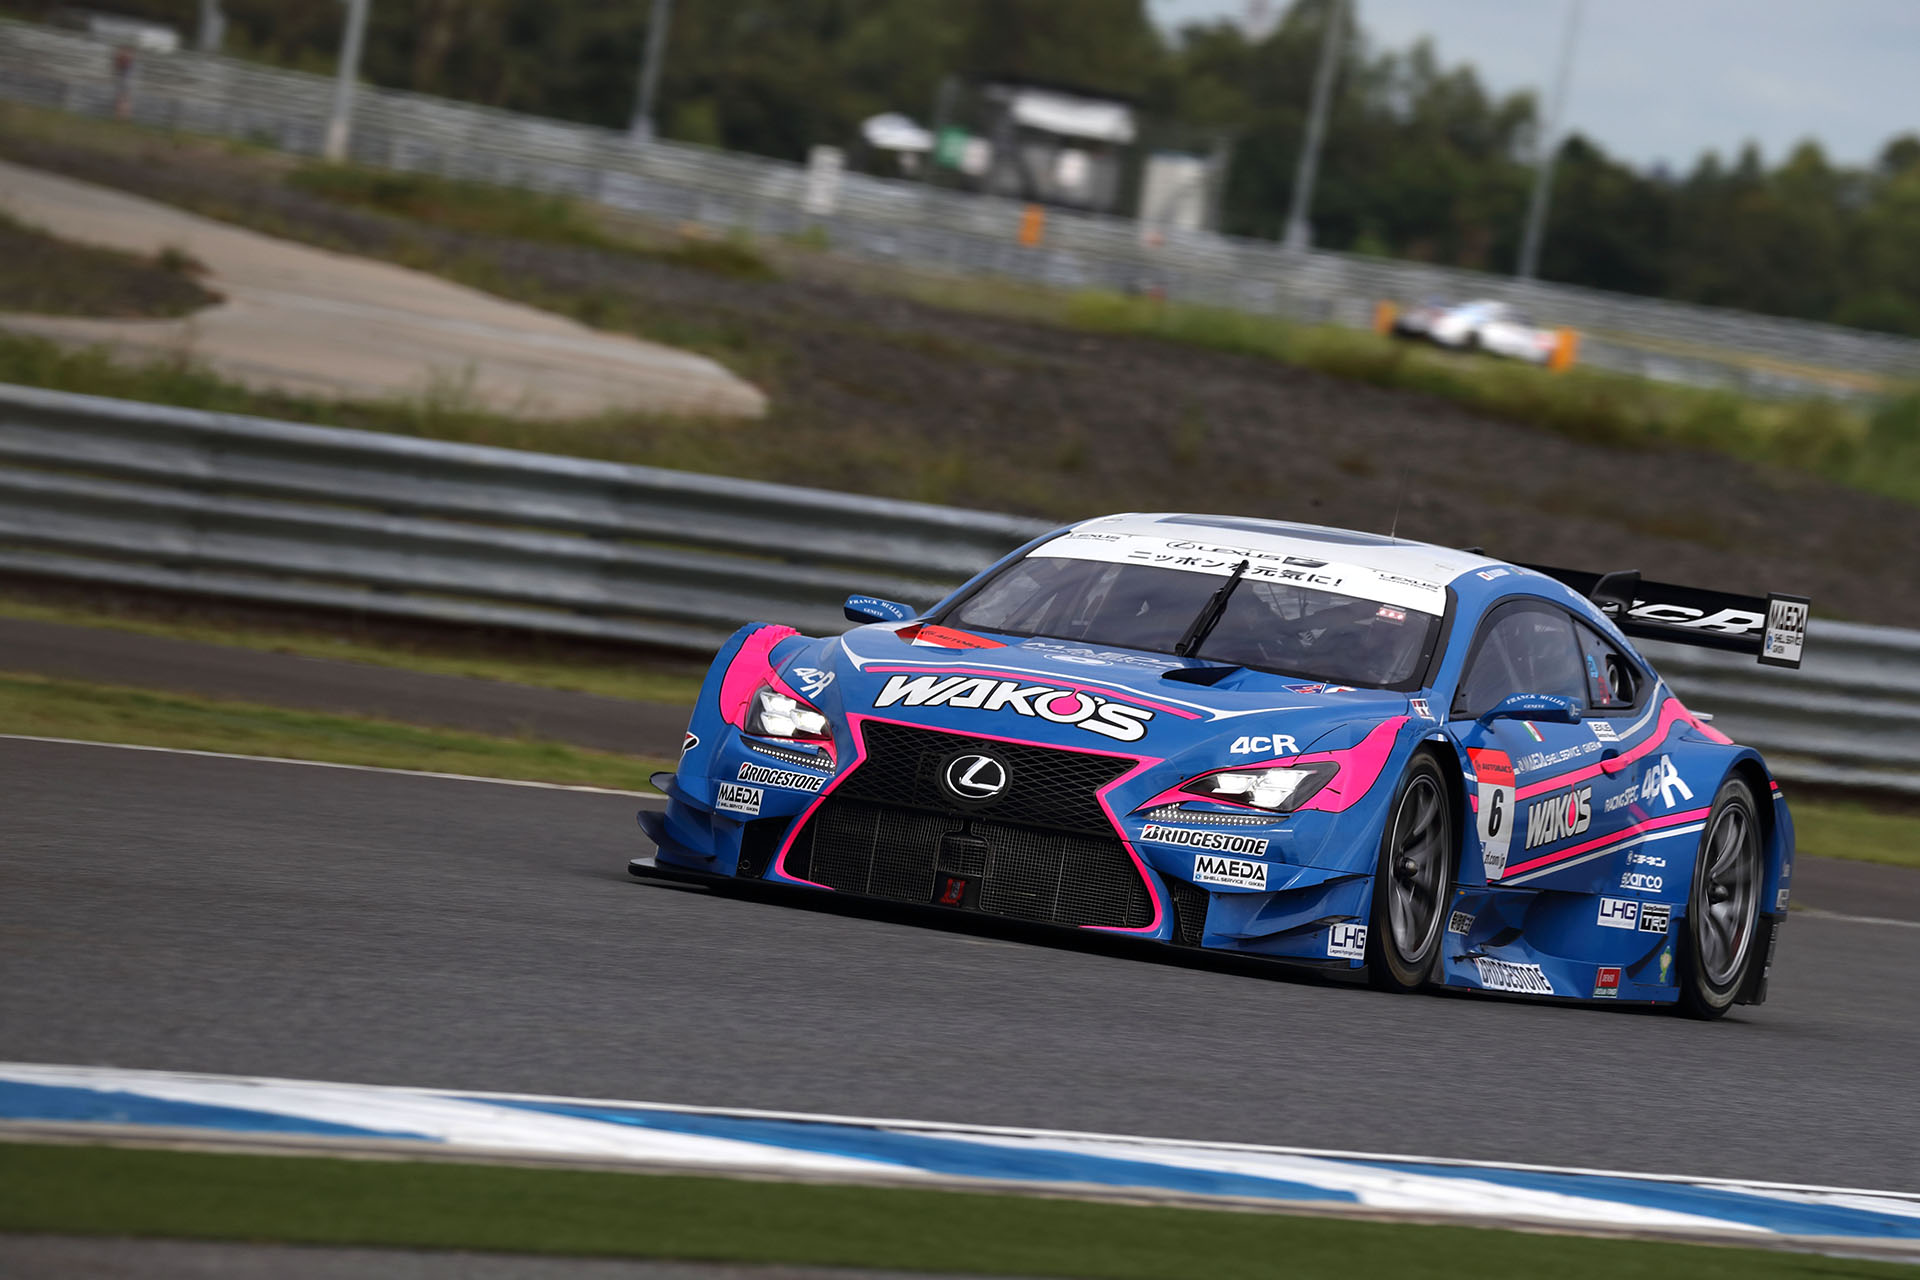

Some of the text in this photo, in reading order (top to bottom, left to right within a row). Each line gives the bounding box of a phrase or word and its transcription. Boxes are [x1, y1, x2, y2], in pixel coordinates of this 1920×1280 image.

[1199, 546, 1281, 561] LEXUS
[793, 667, 836, 699] 4CR
[873, 674, 1155, 743] WAKO'S
[1229, 733, 1301, 756] 4CR
[739, 763, 826, 791] BRIDGESTONE
[1641, 754, 1694, 809] 4CR
[719, 784, 760, 806] MAEDA
[1488, 788, 1504, 837] 6
[1525, 785, 1592, 851] WAKO'S
[1142, 825, 1267, 855] BRIDGESTONE
[1196, 857, 1265, 881] MAEDA
[1220, 876, 1243, 885] SERVICE
[1621, 872, 1663, 889] sparco
[1600, 900, 1636, 920] LHG
[1643, 915, 1667, 932] TRD
[1331, 925, 1366, 949] LHG
